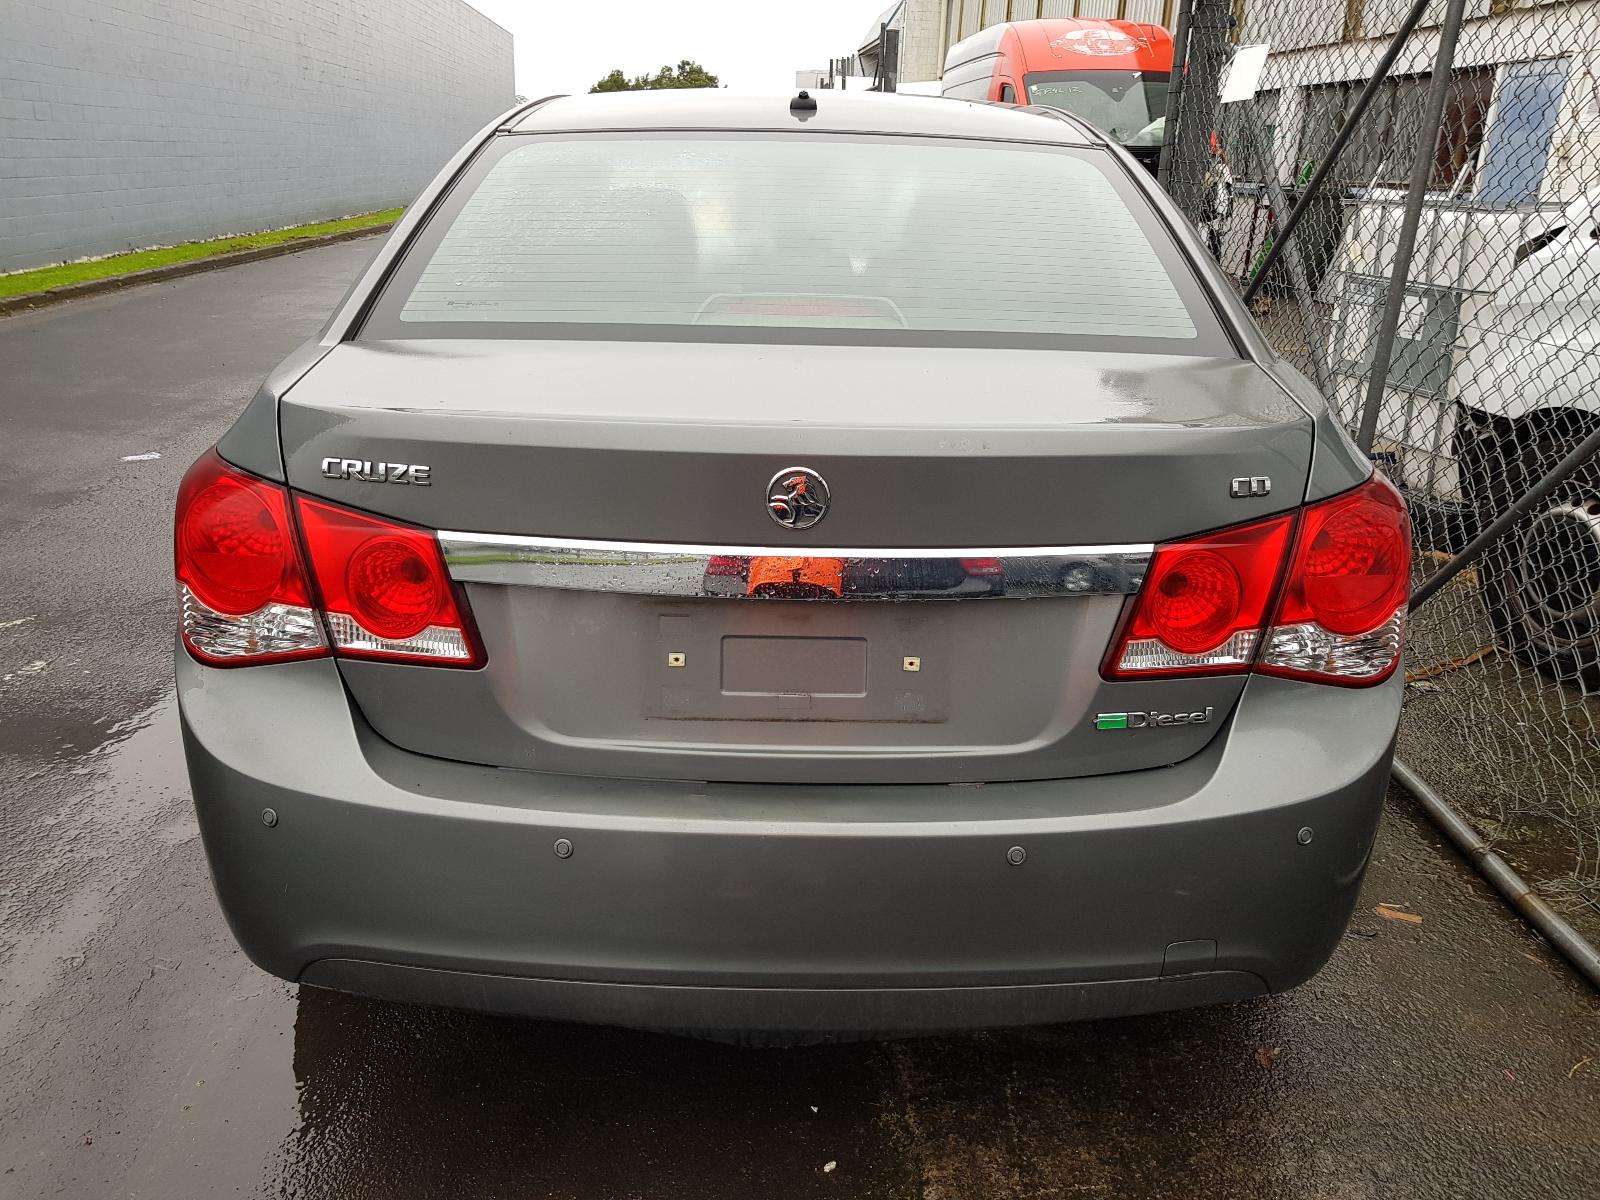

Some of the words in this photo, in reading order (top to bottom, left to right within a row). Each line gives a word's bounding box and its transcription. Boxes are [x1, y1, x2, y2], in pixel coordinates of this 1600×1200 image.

[321, 457, 431, 486] CRUZE
[1230, 476, 1271, 498] CD
[1127, 706, 1214, 728] Diesel
